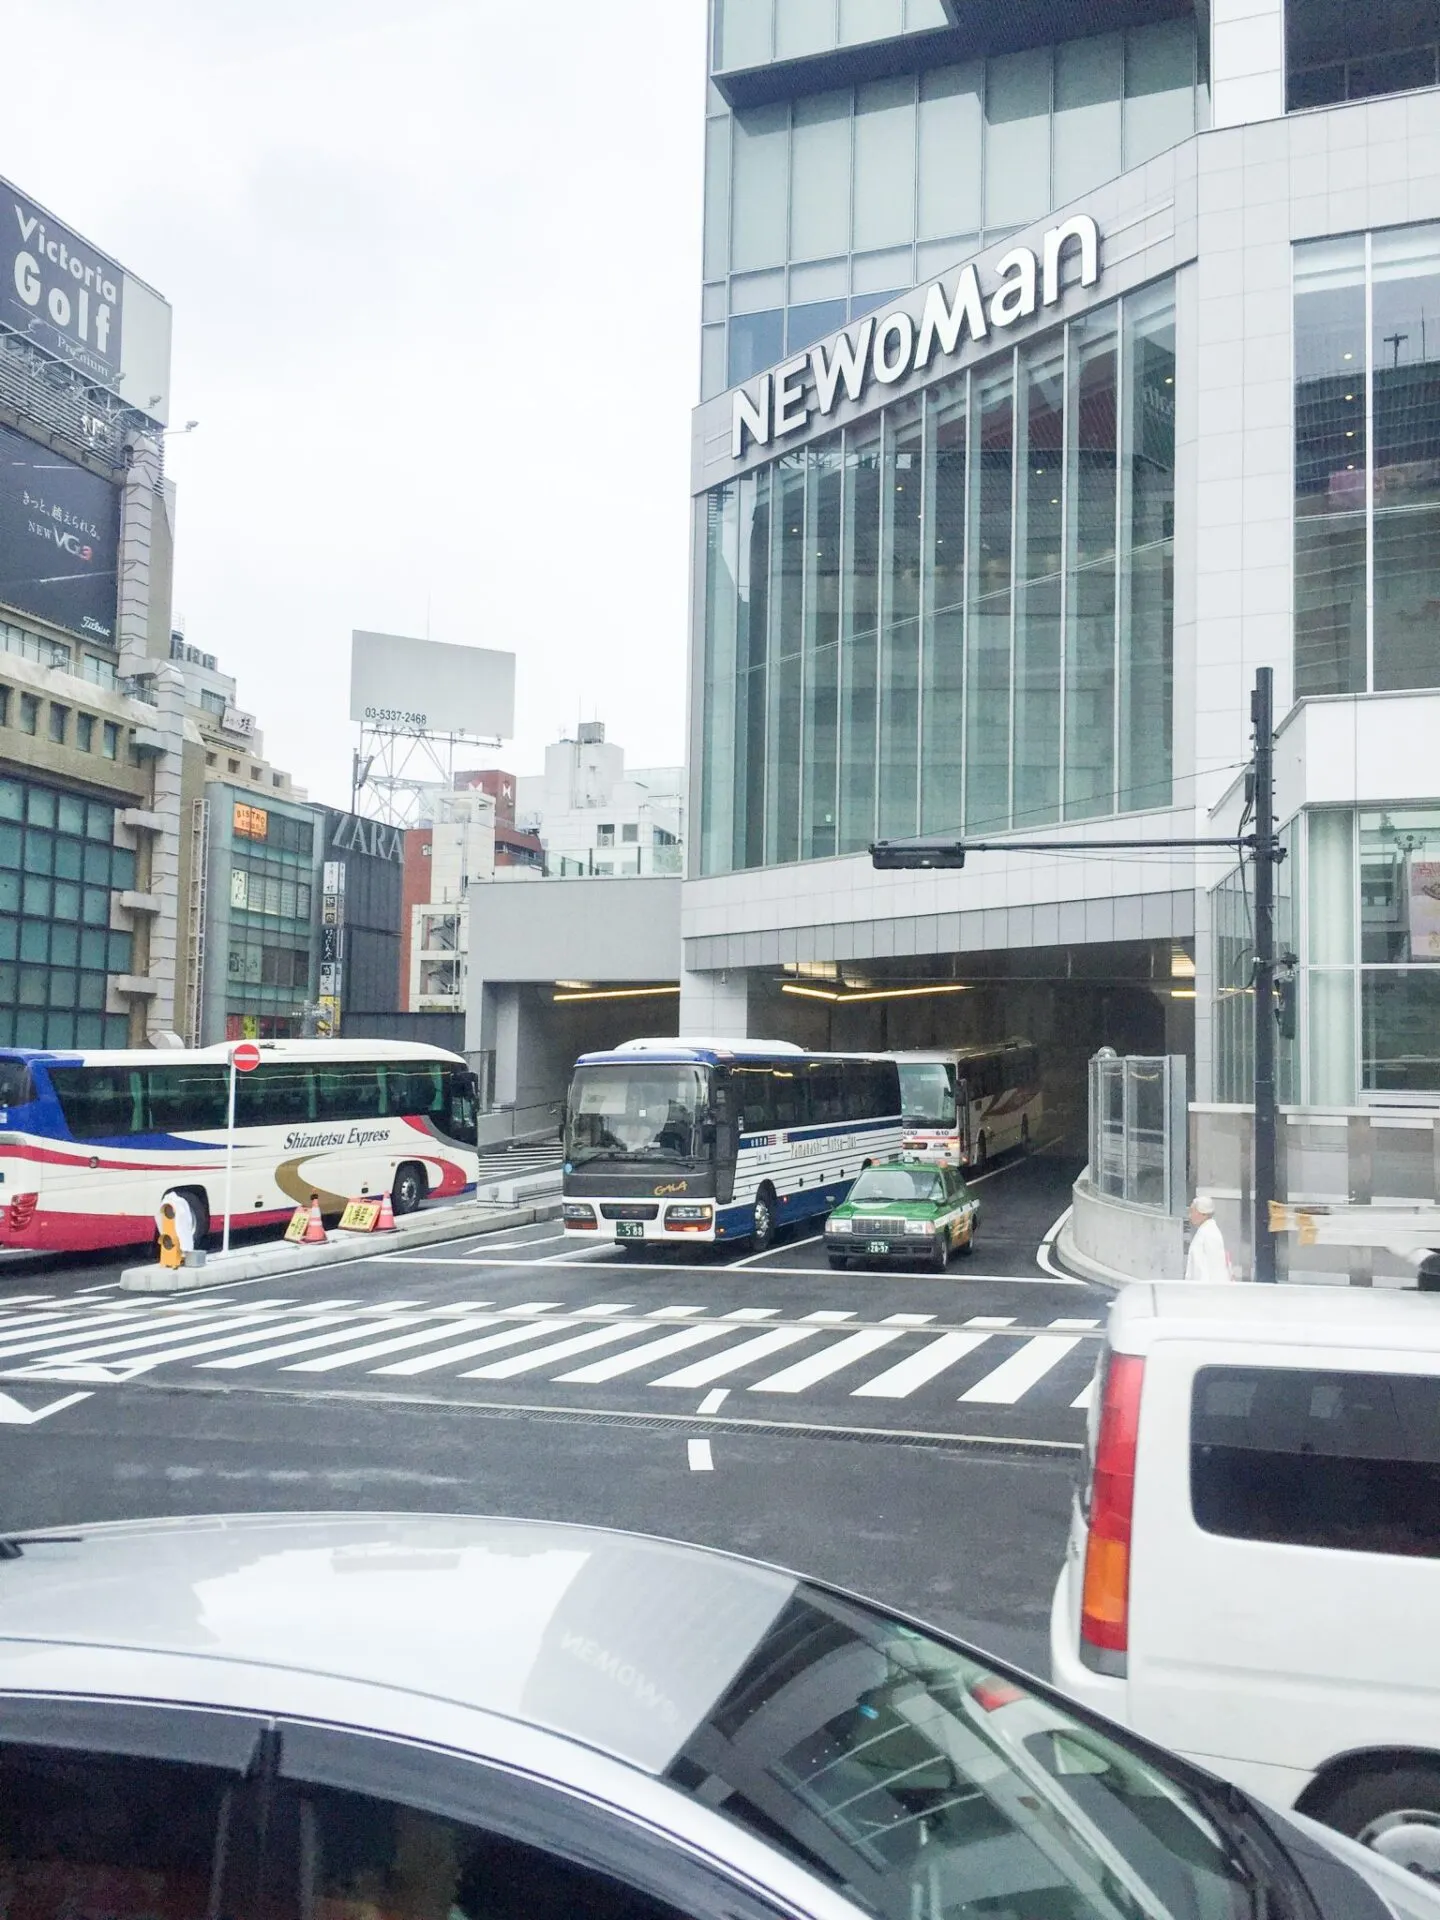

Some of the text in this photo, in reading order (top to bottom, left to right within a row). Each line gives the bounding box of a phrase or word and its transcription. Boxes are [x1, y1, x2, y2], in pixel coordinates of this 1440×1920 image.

[14, 203, 117, 305] Victoria
[14, 250, 110, 354] Golf
[28, 519, 93, 561] NEW VG3
[364, 707, 427, 725] 03-5337-2468
[331, 810, 405, 863] ZARA
[283, 1127, 391, 1150] Shizutetsu Express
[654, 1180, 688, 1196] GALA
